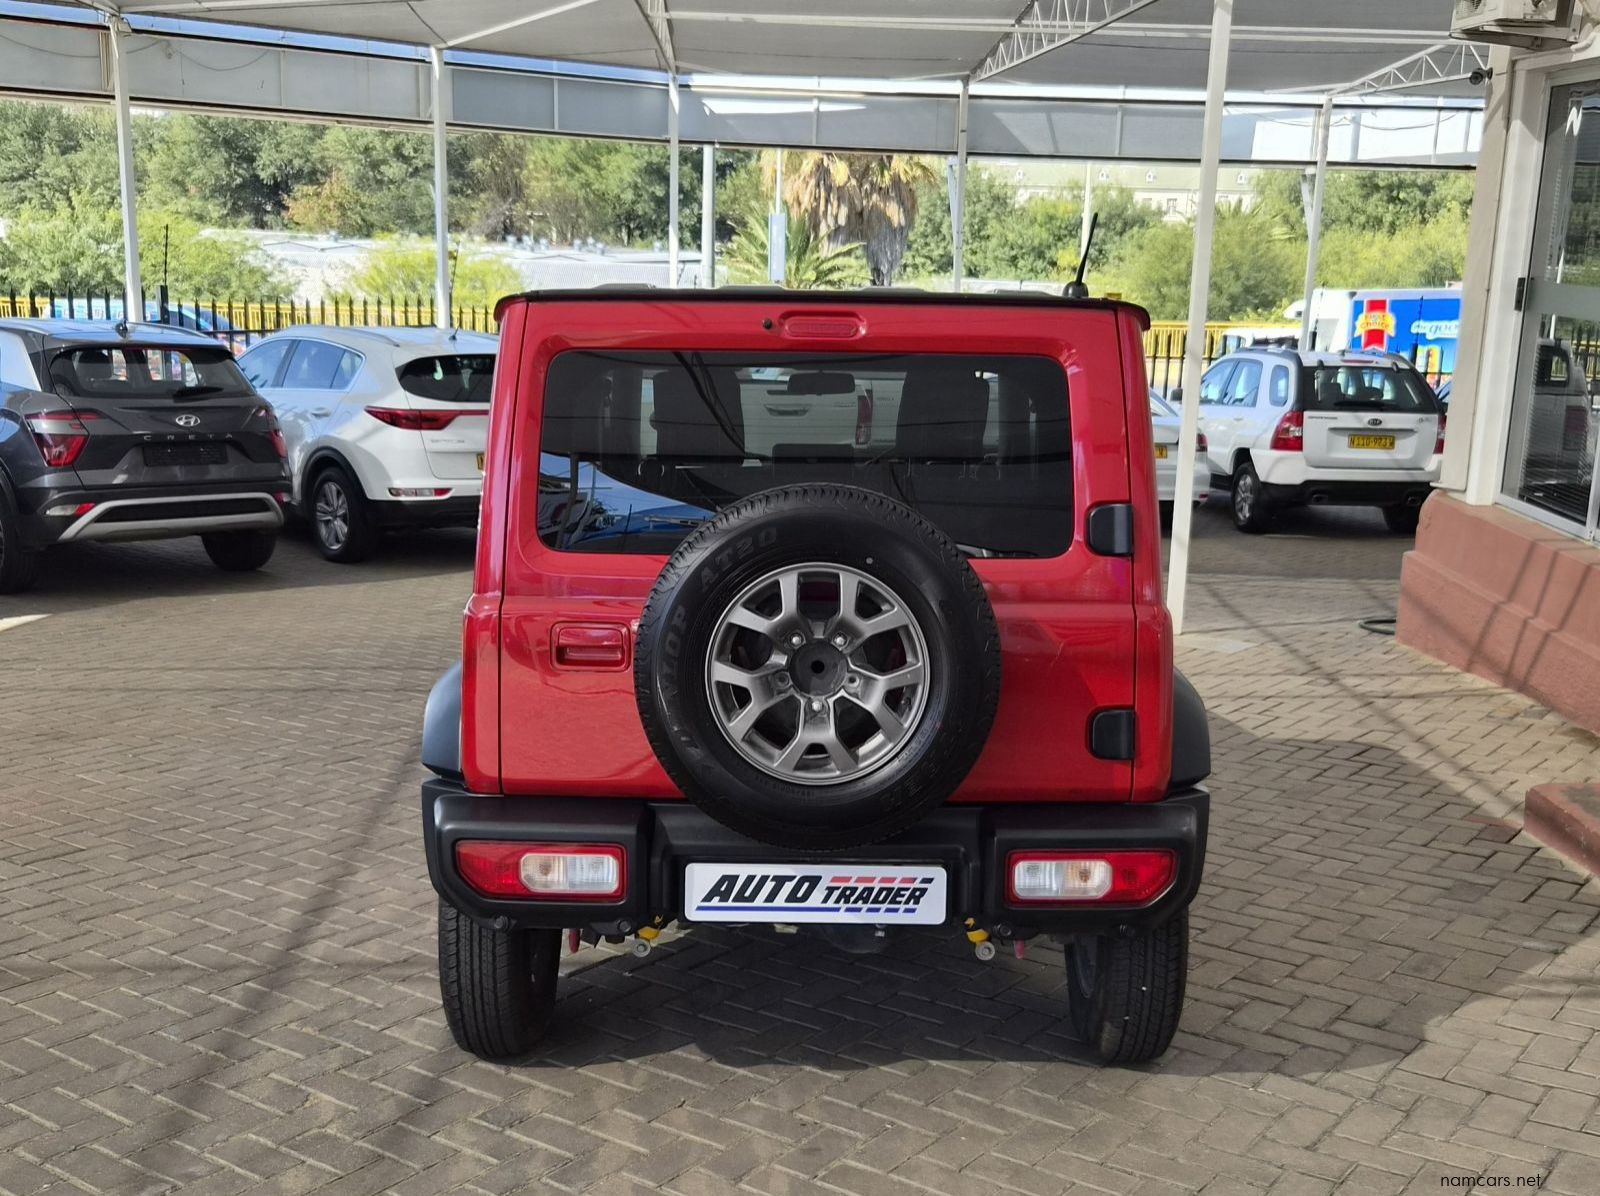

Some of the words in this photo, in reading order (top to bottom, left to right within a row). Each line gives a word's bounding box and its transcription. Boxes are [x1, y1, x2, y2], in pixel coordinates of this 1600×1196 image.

[143, 432, 233, 441] CRETA
[700, 875, 822, 903] AUTO
[821, 886, 929, 906] TRADER
